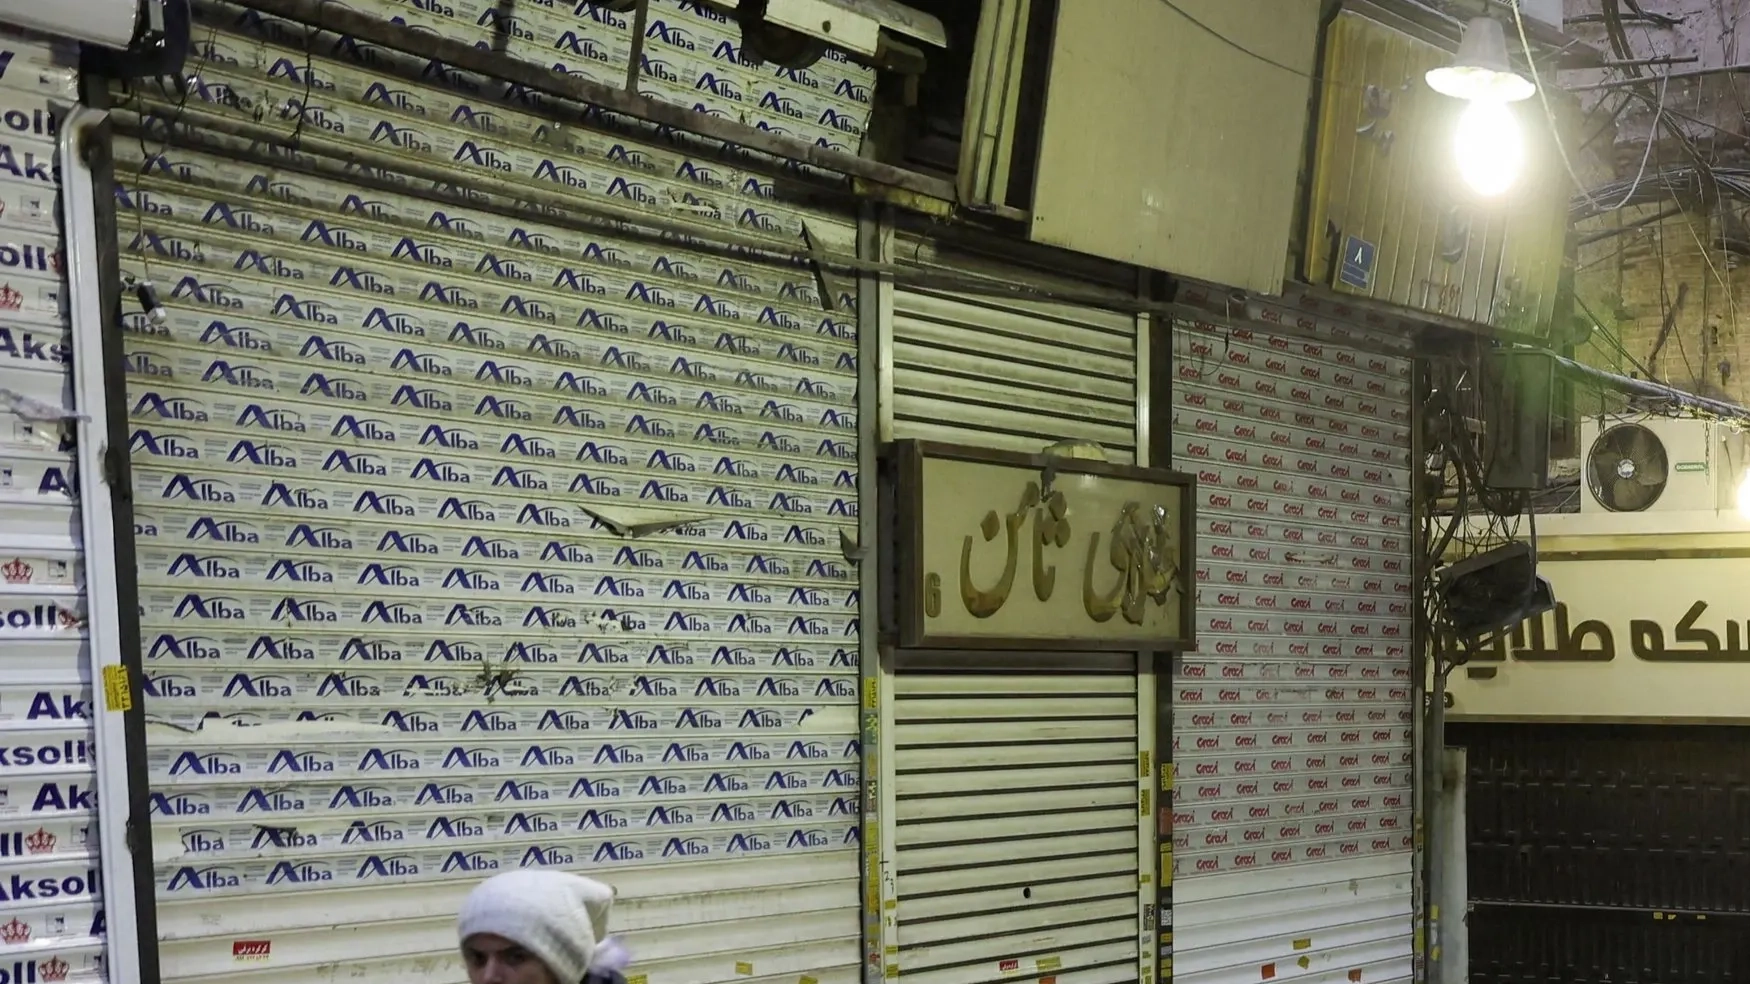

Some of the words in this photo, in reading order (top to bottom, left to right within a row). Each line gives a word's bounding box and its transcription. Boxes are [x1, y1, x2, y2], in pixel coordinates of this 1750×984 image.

[642, 20, 696, 49] Alba
[758, 92, 806, 117] Alba
[818, 108, 860, 131] Alba
[448, 105, 510, 132] Alba
[673, 161, 726, 187] Alba
[606, 177, 657, 203] Alba
[734, 208, 783, 231] Alba
[580, 242, 632, 266] Alba
[650, 256, 697, 278] Alba
[329, 265, 396, 294] Alba
[500, 295, 556, 320] Alba
[550, 268, 607, 294] Alba
[622, 280, 678, 308] Alba
[363, 307, 425, 334] Alba
[446, 322, 506, 348] Alba
[299, 335, 366, 363] Alba
[391, 348, 452, 374] Alba
[202, 360, 274, 389] Alba
[392, 385, 452, 410] Alba
[418, 424, 479, 449] Alba
[499, 433, 557, 457] Alba
[321, 449, 388, 476] Alba
[410, 458, 470, 483] Alba
[491, 466, 548, 490] Alba
[162, 475, 235, 503] Alba
[515, 503, 570, 527] Alba
[286, 523, 352, 549] Alba
[612, 546, 664, 568] Alba
[682, 549, 728, 571] Alba
[168, 552, 240, 578] Alba
[593, 576, 644, 597] Alba
[663, 580, 710, 600] Alba
[925, 571, 941, 618] 6
[173, 593, 246, 620] Alba
[362, 600, 422, 624] Alba
[147, 633, 220, 660] Alba
[423, 638, 484, 662] Alba
[558, 675, 610, 696] Alba
[694, 677, 740, 696] Alba
[461, 708, 517, 732] Alba
[675, 708, 722, 728] Alba
[358, 747, 419, 771] Alba
[592, 743, 644, 764] Alba
[786, 740, 828, 758] Alba
[494, 779, 550, 802] Alba
[568, 776, 620, 798] Alba
[577, 808, 628, 830] Alba
[646, 804, 693, 826] Alba
[592, 840, 644, 862] Alba
[662, 836, 709, 857] Alba
